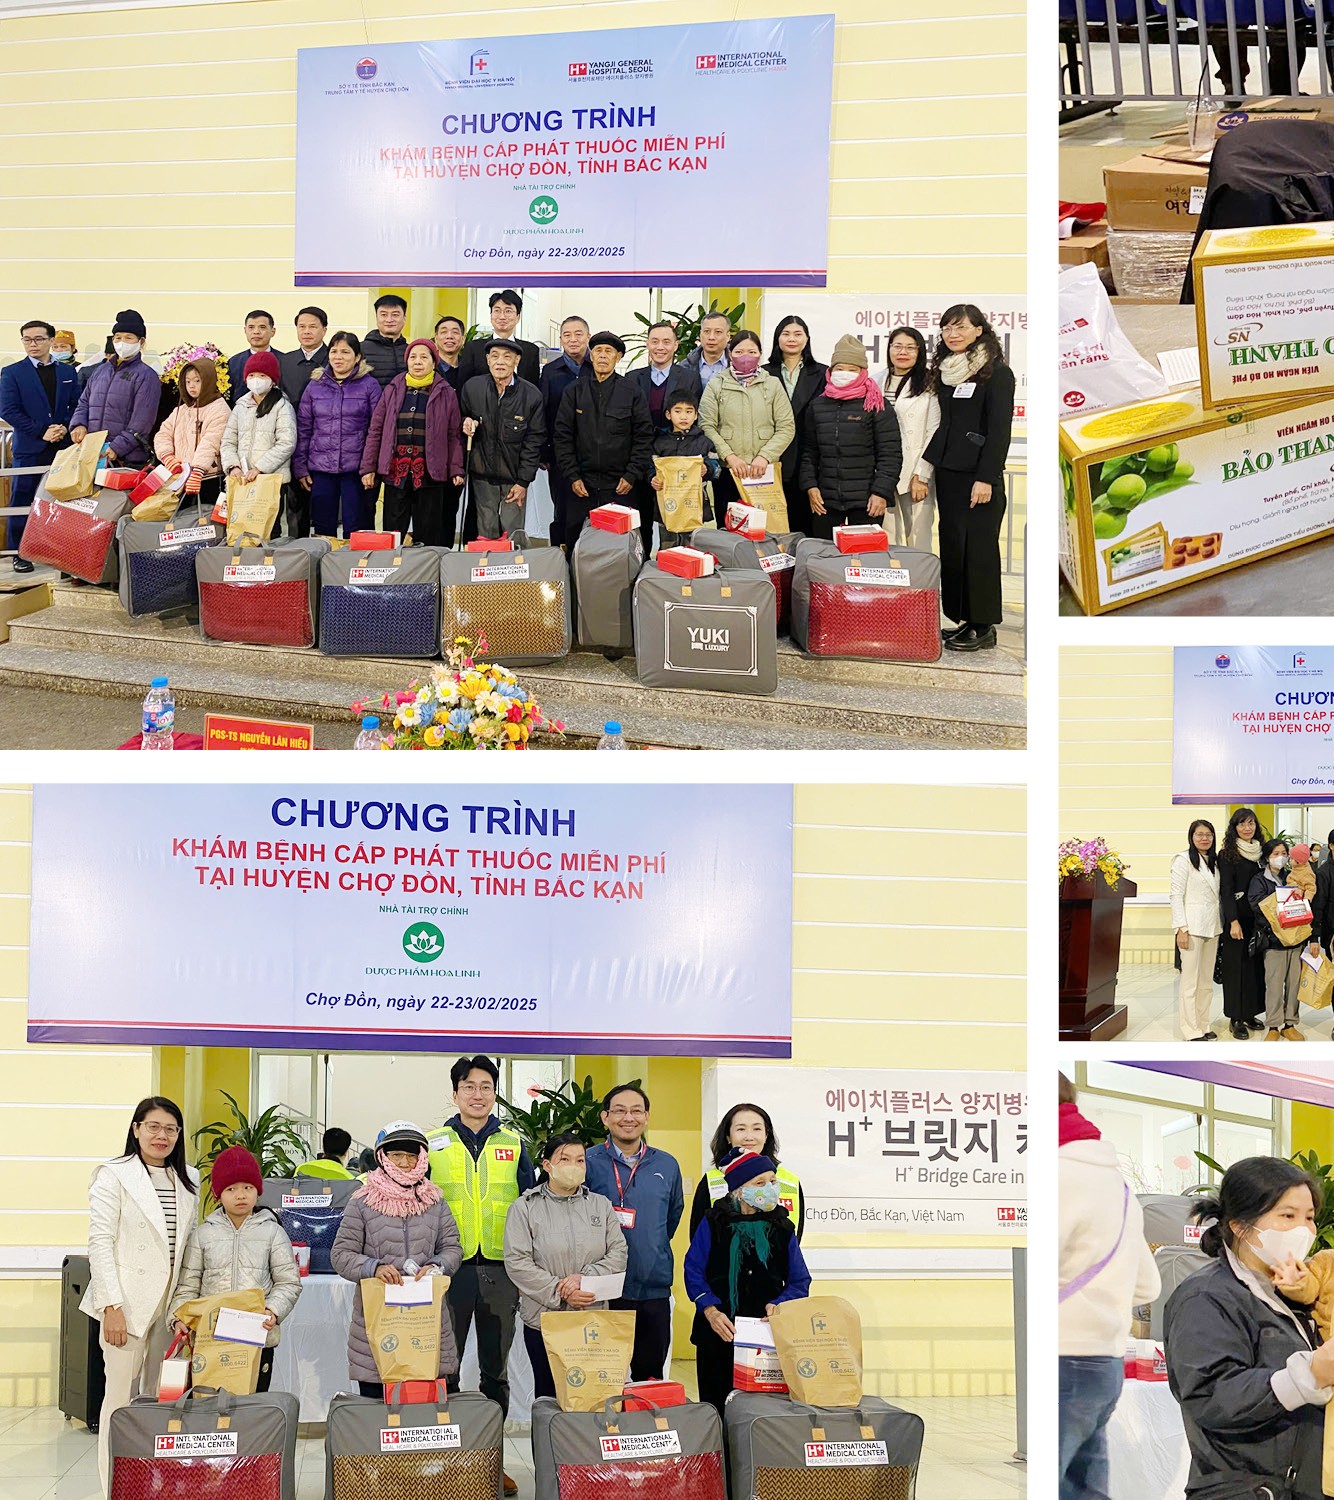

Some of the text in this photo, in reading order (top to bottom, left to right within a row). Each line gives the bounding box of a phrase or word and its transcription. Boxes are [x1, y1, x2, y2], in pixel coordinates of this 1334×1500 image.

[589, 59, 653, 69] YANGJI GENERAL
[717, 51, 783, 61] INTERNATIONAL
[717, 58, 787, 68] MEDICAL CENTER
[442, 102, 656, 135] CHƯƠNG TRÌNH
[380, 131, 726, 162] KHÁM BỆNH CẤP PHÁT THUỐC MIỄN PHÍ
[394, 166, 418, 181] TẠI
[424, 162, 480, 181] HUYỆN
[485, 163, 525, 179] CHỢ
[578, 157, 617, 174] TỈNH
[624, 155, 662, 172] BẮC
[668, 156, 707, 174] KẠN
[463, 248, 487, 259] Chợ
[517, 248, 545, 259] ngày
[548, 246, 625, 257] 22-23/02/2025
[1229, 341, 1319, 366] THANH
[1221, 450, 1273, 483] BẢO
[687, 627, 730, 643] YUKI
[704, 644, 730, 652] LUXURY
[210, 730, 307, 749] PGS-TS NGUYỄN LÂN HIẾU
[271, 797, 575, 837] CHƯƠNG TRÌNH
[172, 834, 666, 874] KHÁM BỆNH CẤP PHÁT THUỐC MIỄN PHÍ
[194, 866, 234, 890] TẠI
[243, 867, 330, 893] HUYỆN
[338, 871, 396, 896] CHỢ
[470, 873, 525, 896] TỈNH
[534, 875, 585, 898] BẮC
[593, 880, 643, 904] KẠN
[379, 904, 469, 916] NHÀ TÀI TRỢ CHÍNH
[365, 966, 481, 978] DƯỢC PHẨM HOA LINH
[305, 991, 538, 1011] Chợ Đồn, ngày 22-23/02/2025
[826, 1089, 1027, 1115] 에이치플러스 양지병
[882, 1118, 998, 1163] 브릿지
[918, 1168, 967, 1187] Bridge
[973, 1169, 1006, 1184] Care
[1011, 1169, 1024, 1184] in
[805, 1207, 964, 1223] Chợ Đồn, Bắc Kạn, Việt Nam
